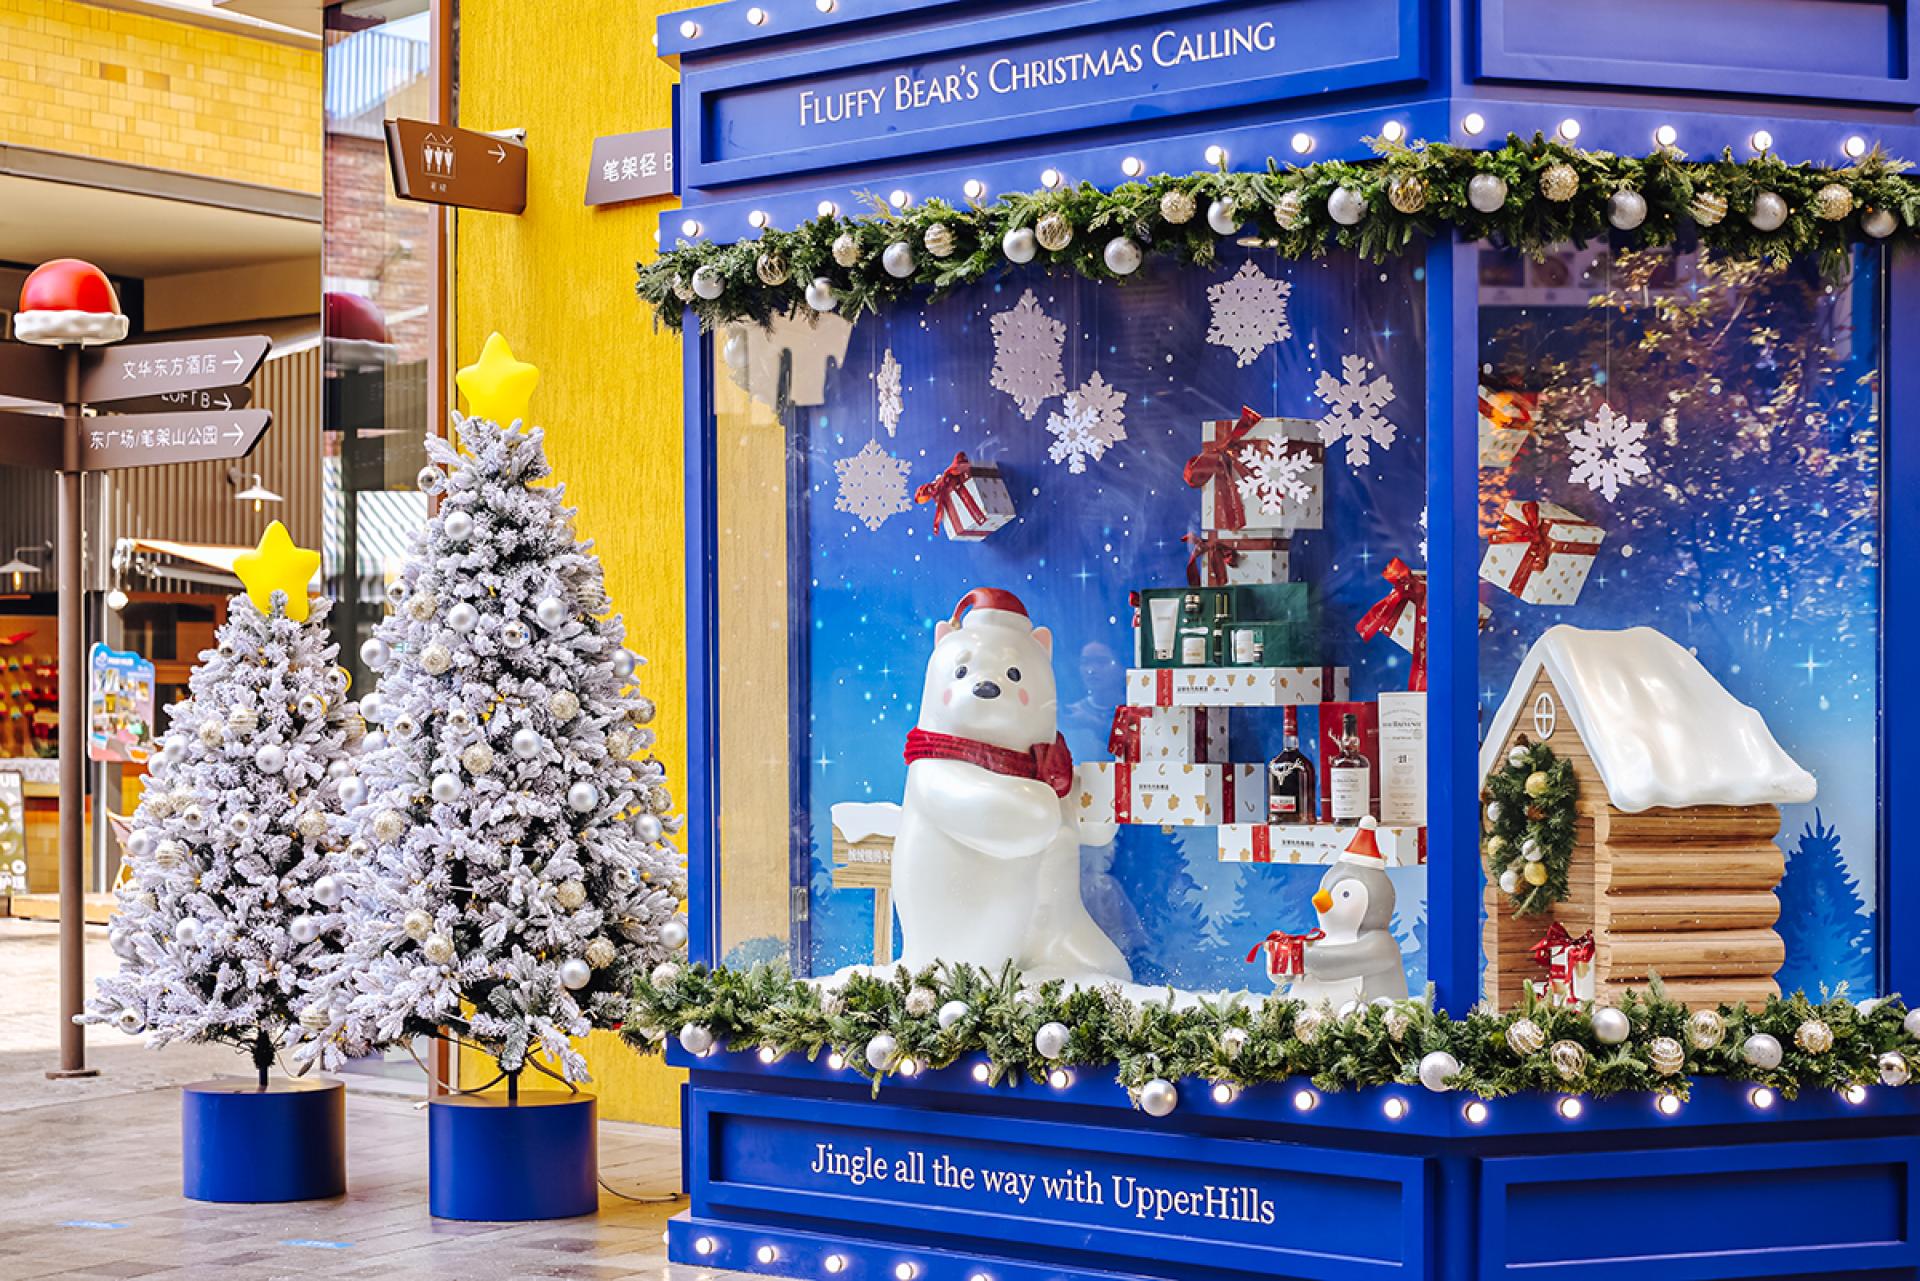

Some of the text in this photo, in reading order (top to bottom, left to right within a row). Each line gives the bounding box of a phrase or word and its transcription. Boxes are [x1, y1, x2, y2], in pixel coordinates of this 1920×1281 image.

[799, 86, 887, 126] FLUFFY
[988, 44, 1143, 94] CHRISTMAS
[1151, 21, 1276, 67] CALLING
[602, 152, 657, 182] 笔架径
[122, 354, 217, 380] 文华东方酒店
[200, 391, 211, 409] B
[89, 424, 219, 450] 东广场/笔架山公园
[811, 1143, 1275, 1225] Jingle all the way with UpperHills
